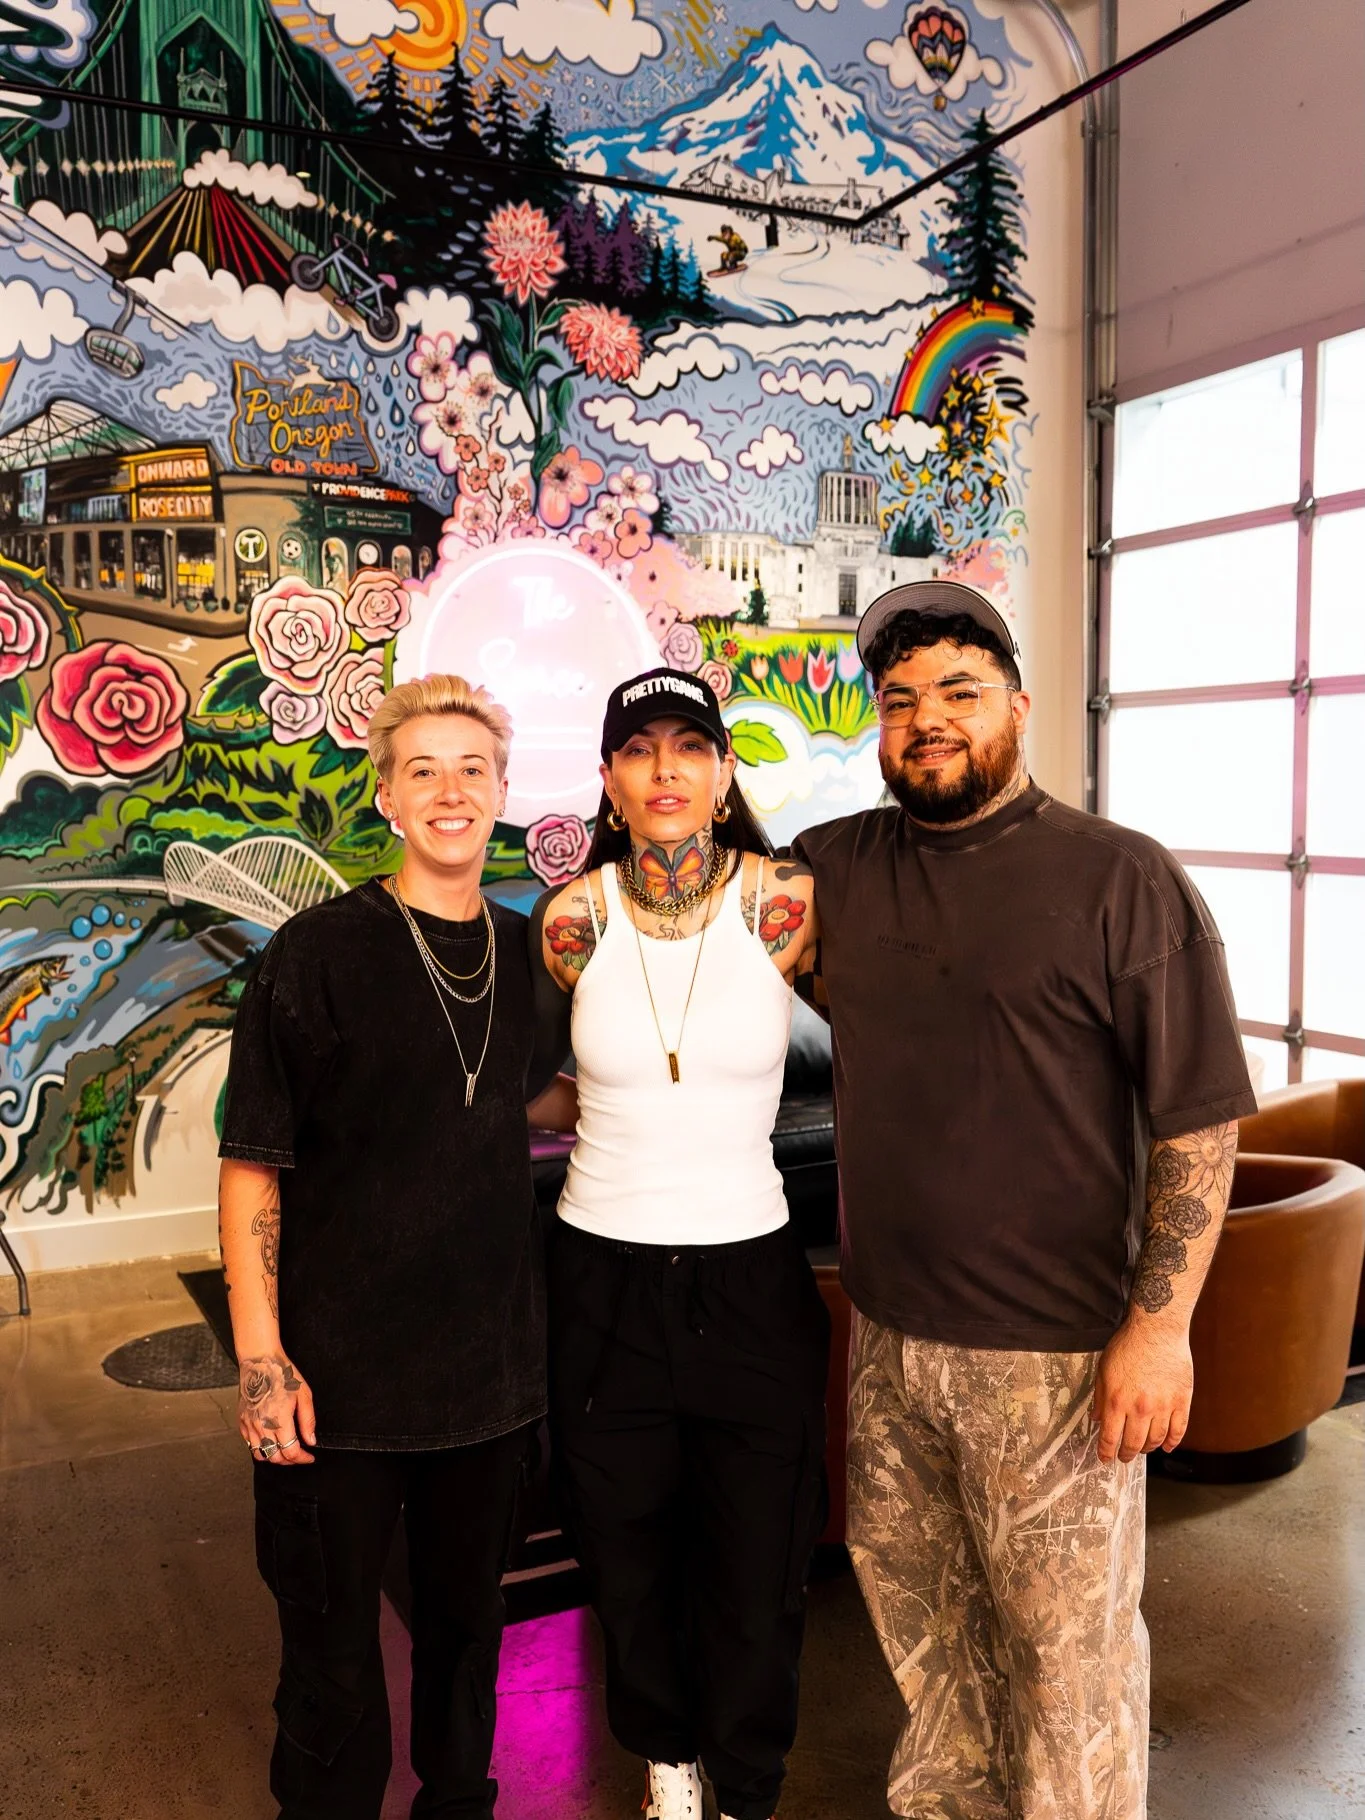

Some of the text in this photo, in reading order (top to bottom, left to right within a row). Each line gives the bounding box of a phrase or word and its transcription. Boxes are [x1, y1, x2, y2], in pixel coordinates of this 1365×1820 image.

[243, 388, 352, 425] Portland
[270, 420, 354, 458] Oregon
[137, 458, 210, 483] ONWARD
[270, 458, 358, 476] OLD TOWN
[512, 576, 576, 629] The
